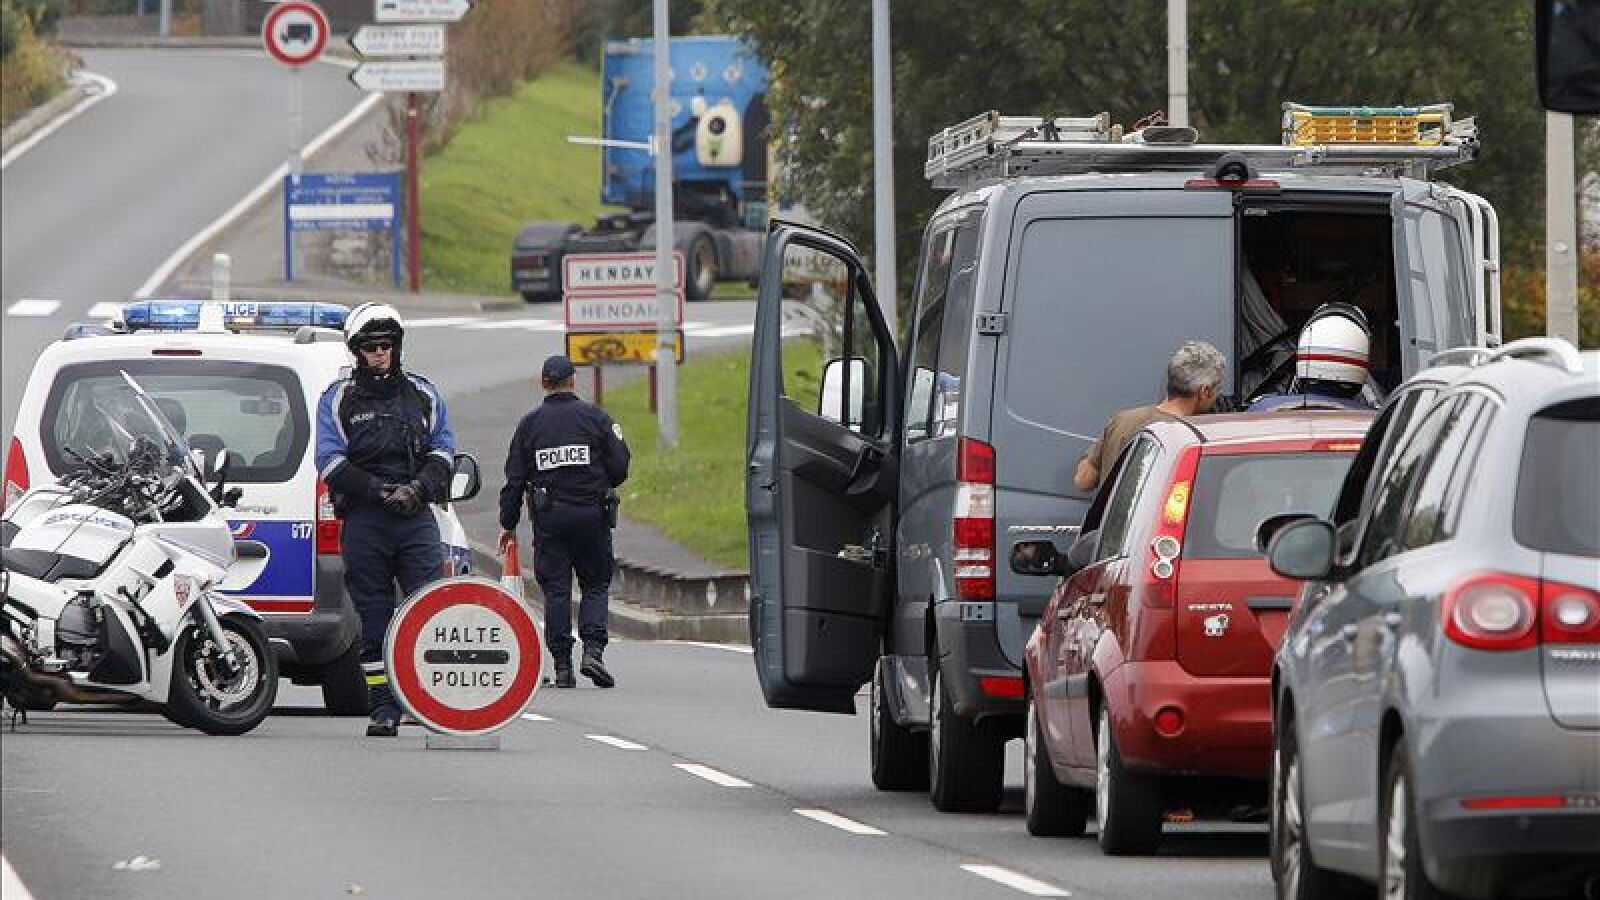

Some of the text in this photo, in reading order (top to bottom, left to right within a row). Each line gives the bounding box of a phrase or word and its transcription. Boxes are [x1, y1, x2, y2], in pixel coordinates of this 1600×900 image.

[581, 265, 657, 281] HENDAY
[224, 303, 257, 315] LICE
[581, 302, 659, 319] HENDAI
[539, 447, 587, 466] POLICE
[435, 627, 501, 643] HALTE
[432, 671, 503, 687] POLICE
